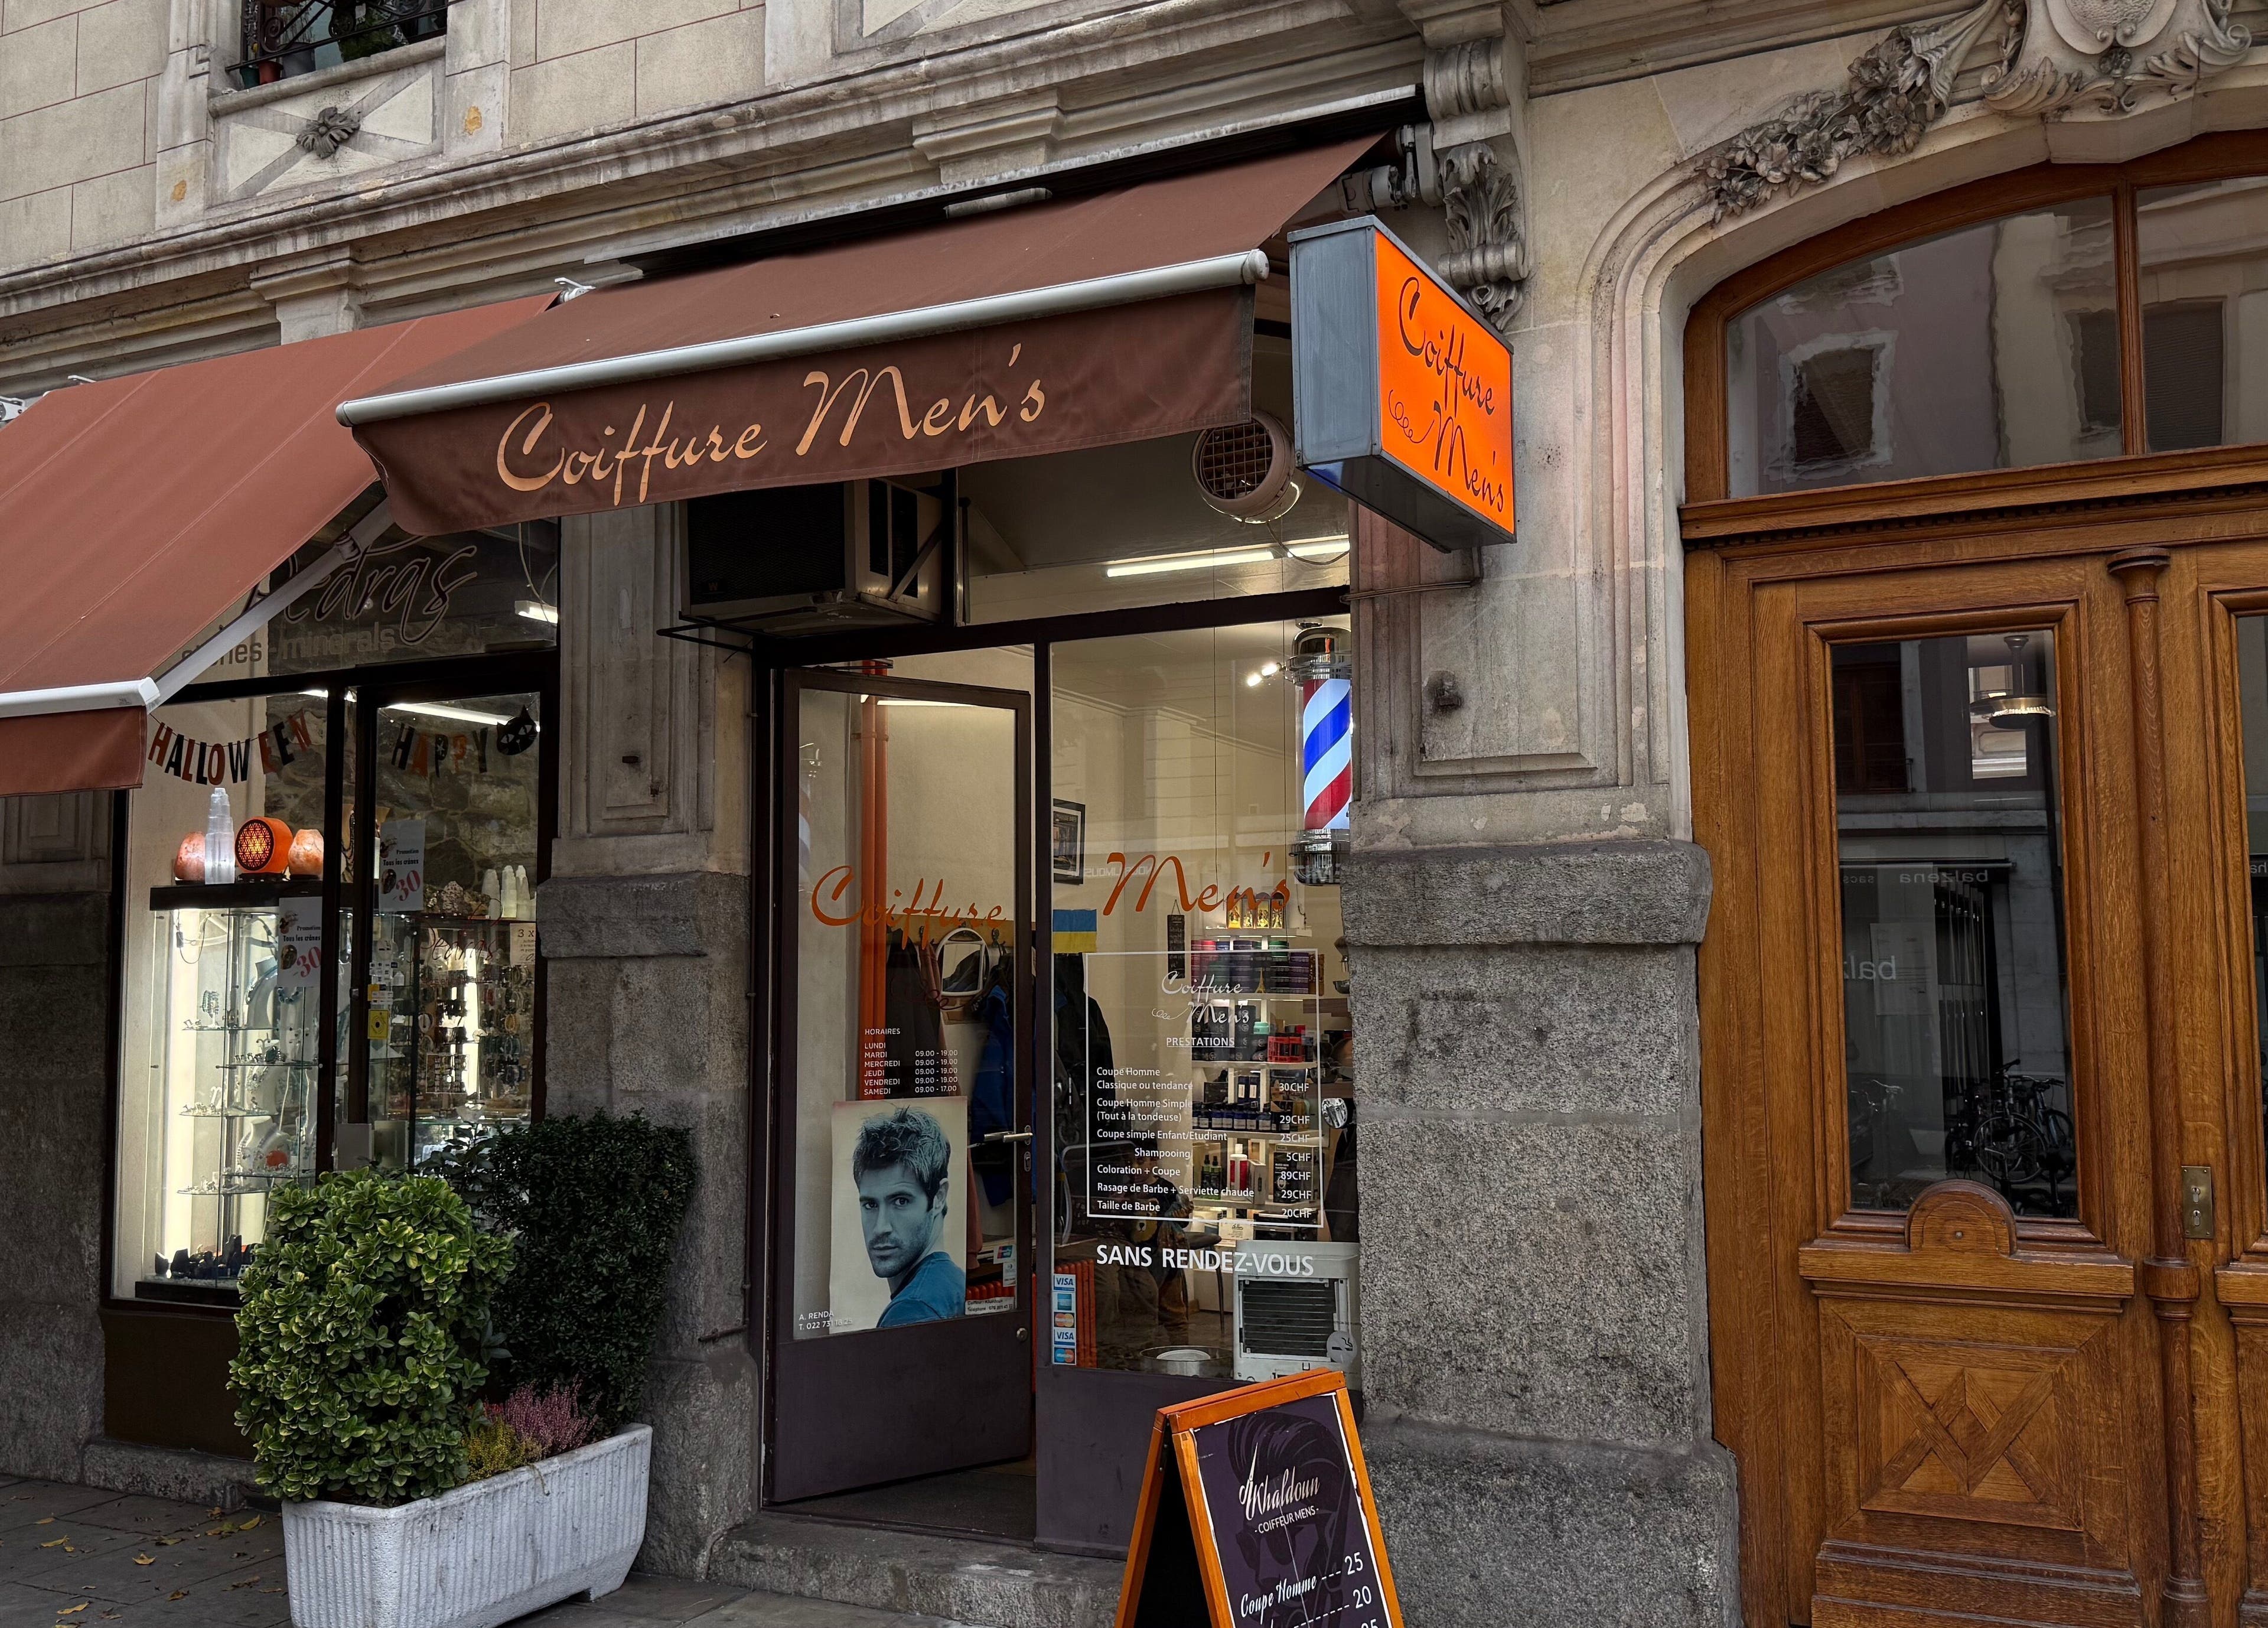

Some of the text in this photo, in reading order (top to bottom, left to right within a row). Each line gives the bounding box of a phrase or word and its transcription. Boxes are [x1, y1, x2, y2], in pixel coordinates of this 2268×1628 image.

[1399, 276, 1495, 418] Coiffure
[498, 343, 1046, 506] Coiffure Men's
[1433, 401, 1504, 512] Men's
[282, 621, 396, 660] minerals
[148, 708, 311, 785] HALLOWEEN
[391, 722, 488, 778] HAPPY
[1103, 851, 1291, 916] Men's
[812, 865, 1006, 950] Coiffure
[1162, 971, 1243, 1002] Coiffure
[1186, 1001, 1249, 1024] Men's
[1166, 1037, 1235, 1046] PRESTATIONS
[1097, 1067, 1161, 1078] Coupe Homme
[1097, 1080, 1137, 1090] Classique
[1152, 1082, 1193, 1090] tendance
[1097, 1098, 1125, 1108] Coupe
[1126, 1099, 1161, 1107] Homme
[1097, 1111, 1119, 1121] (Tout
[1121, 1111, 1126, 1120] à
[1128, 1112, 1136, 1120] la
[1138, 1112, 1182, 1122] tondeuse)
[1280, 1115, 1310, 1124] 29CHF
[1097, 1129, 1310, 1142] Coupe simple Enfant/Etudiant 25CHF
[1135, 1148, 1311, 1162] Shampooing 5CHF
[1097, 1164, 1142, 1174] Coloration
[1152, 1166, 1181, 1176] Coupe
[1280, 1171, 1311, 1181] 89CHF
[1097, 1183, 1128, 1194] Rasage
[1130, 1184, 1140, 1193] de
[1143, 1185, 1168, 1194] Barbe
[1178, 1186, 1218, 1196] Serviette
[1221, 1187, 1254, 1197] chaude
[1281, 1190, 1312, 1199] 29CHF
[1097, 1200, 1312, 1218] Taille de Barbe 20CHF
[1096, 1245, 1314, 1277] SANS RENDEZ-VOUS
[806, 1321, 820, 1330] 022
[808, 1311, 834, 1320] RENDA
[1057, 1331, 1074, 1340] VISA
[1239, 1443, 1321, 1520] Khaldoun
[1258, 1513, 1295, 1534] COIFFEUR
[1294, 1505, 1316, 1521] MENS
[1240, 1552, 1364, 1625] Coupe Homme 25
[1353, 1585, 1372, 1609] 20
